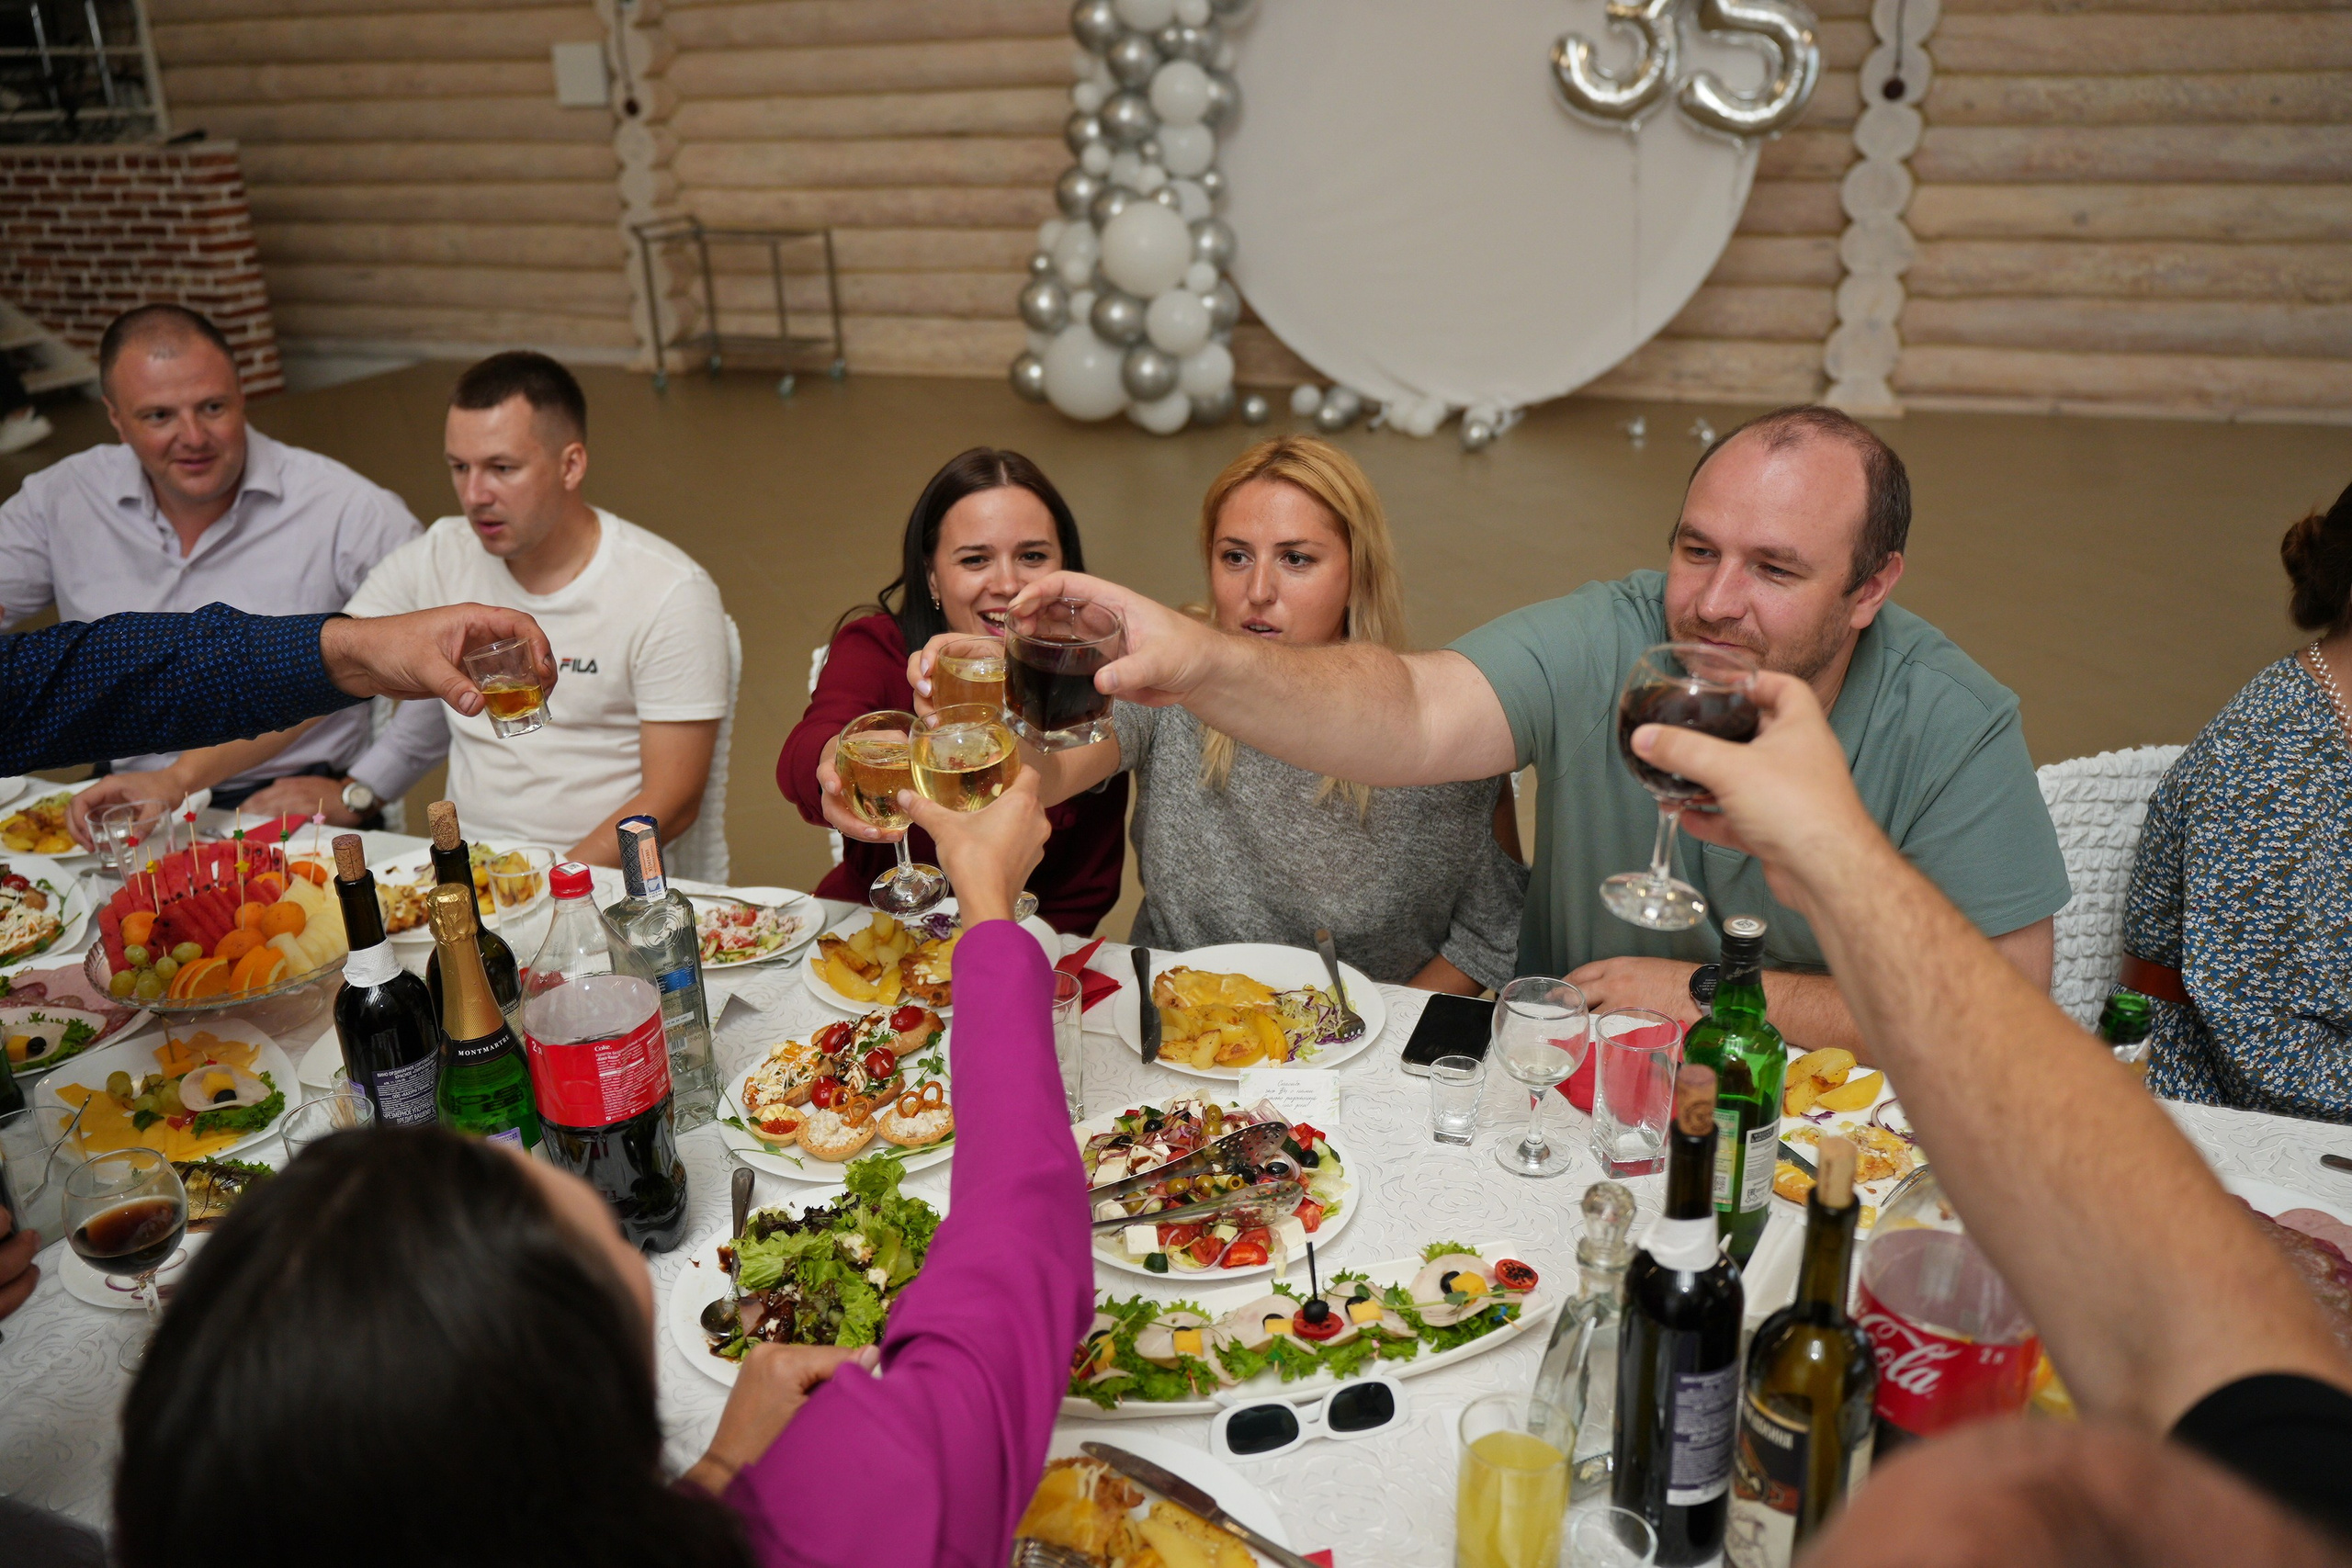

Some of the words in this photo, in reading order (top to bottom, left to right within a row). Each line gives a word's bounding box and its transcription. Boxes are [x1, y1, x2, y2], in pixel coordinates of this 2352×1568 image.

[1549, 0, 1820, 141] 35
[559, 657, 598, 673] FILA
[458, 1034, 510, 1056] MONTMARTRE
[531, 1040, 537, 1053] 2
[389, 1066, 413, 1076] ОРДИНАРНОЕ
[394, 1070, 413, 1079] КРАСНОЕ
[383, 1109, 412, 1119] ЧРЕЗМЕРНОЕ
[397, 1116, 413, 1124] ВРЕДИТ
[414, 1109, 431, 1120] ВАШЕМУ
[1978, 1347, 1994, 1365] 2
